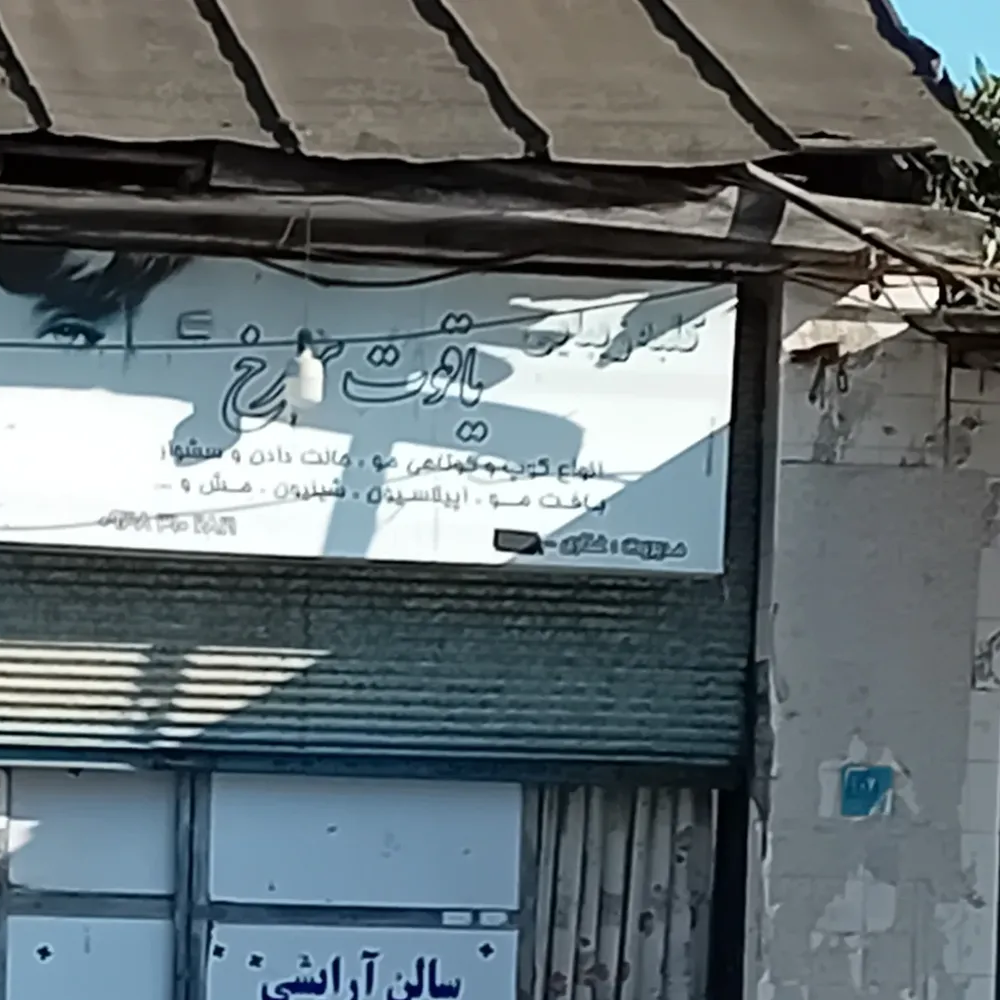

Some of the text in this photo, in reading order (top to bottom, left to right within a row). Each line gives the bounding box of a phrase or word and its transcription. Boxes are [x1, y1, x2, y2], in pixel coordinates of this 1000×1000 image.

[342, 312, 488, 442] یاقوت
[230, 448, 242, 464] و
[371, 453, 399, 472] مو
[488, 492, 531, 509] مو
